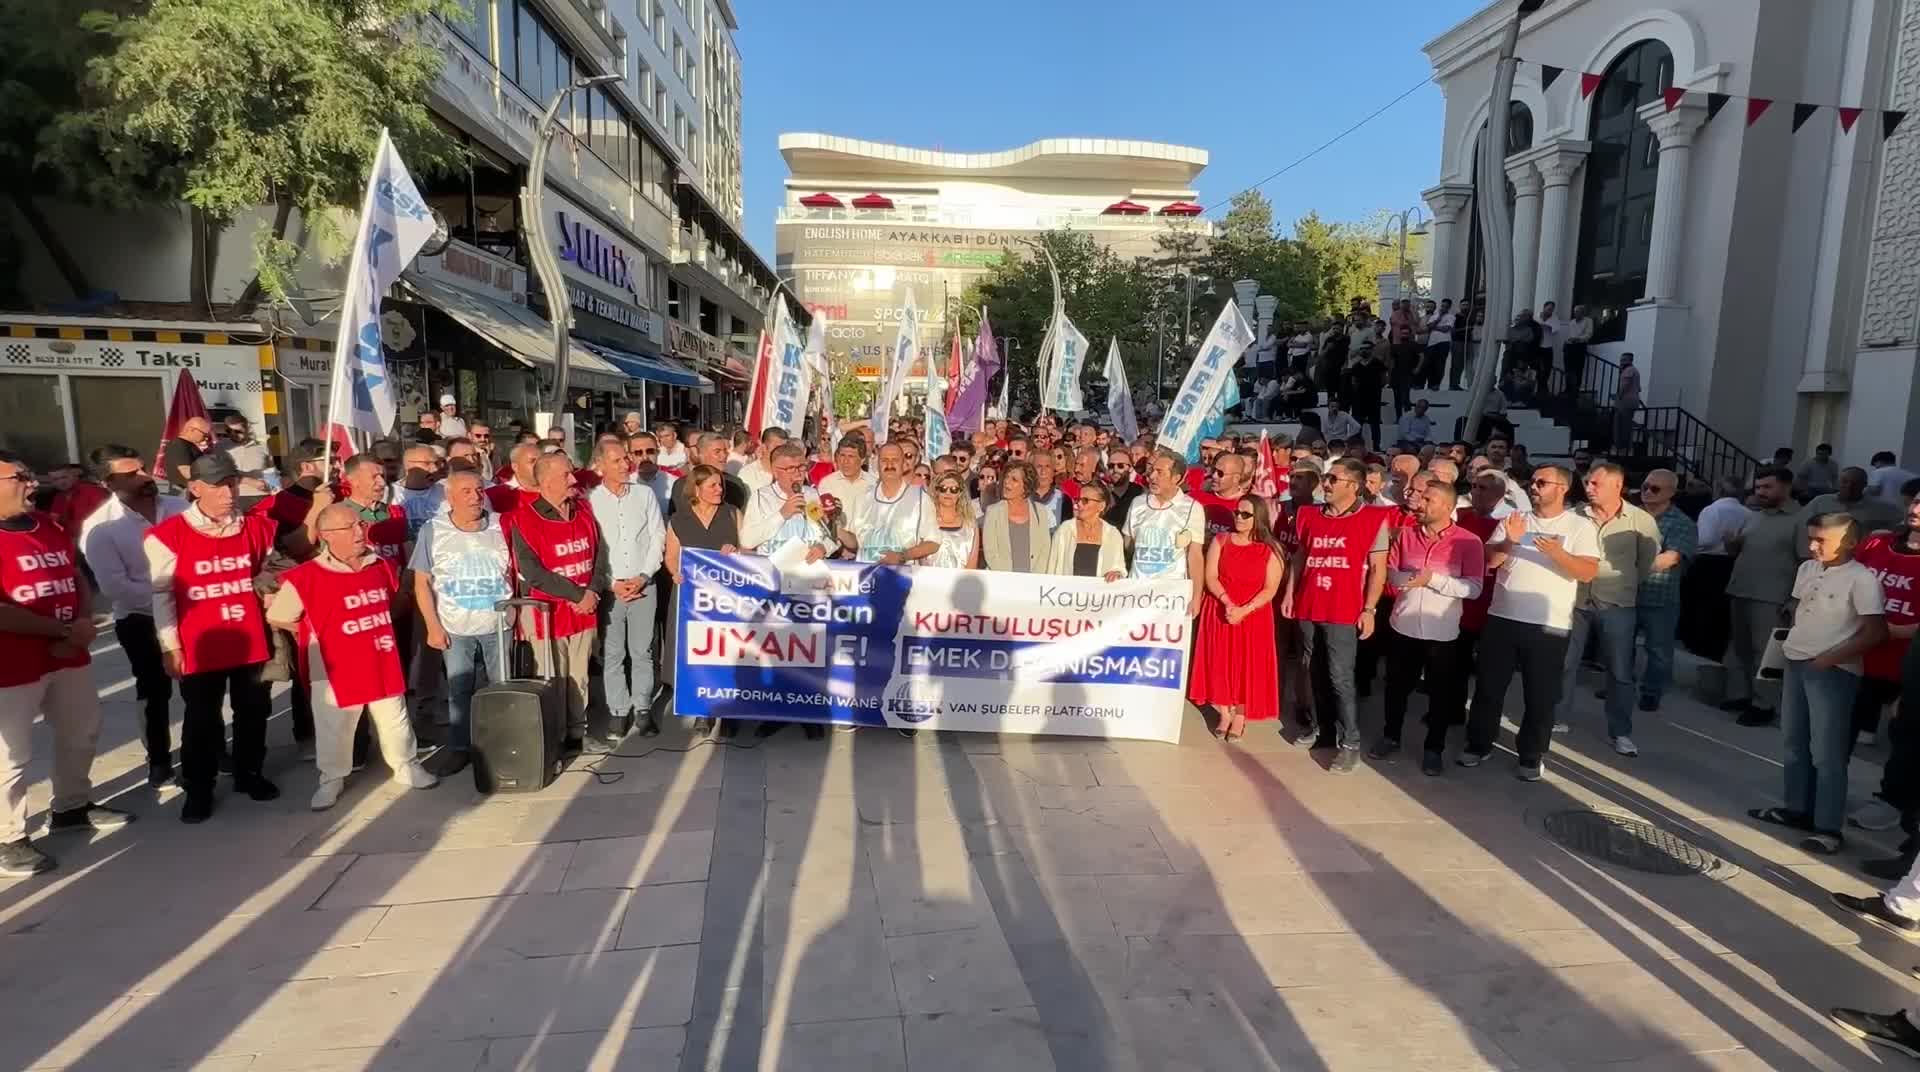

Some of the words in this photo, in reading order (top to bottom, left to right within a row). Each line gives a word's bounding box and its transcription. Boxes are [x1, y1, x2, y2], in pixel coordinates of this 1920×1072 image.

[805, 227, 850, 240] ENGLISH
[851, 228, 881, 241] HOME
[889, 231, 969, 244] AYAKKABI
[805, 269, 857, 281] TIFFANY
[136, 350, 201, 368] Taksi
[195, 379, 240, 391] Murat
[1163, 345, 1227, 440] KESK
[555, 537, 590, 557] DİSK
[16, 549, 71, 572] DİSK
[194, 553, 252, 575] DİSK
[552, 558, 593, 577] GENE
[1306, 555, 1350, 569] GENEL
[11, 576, 76, 603] GENE
[187, 577, 253, 600] GENE
[693, 588, 873, 625] Berxwedan
[1039, 585, 1186, 613] Kayyımdan
[221, 603, 246, 622] İŞ
[341, 610, 393, 635] GEN
[1124, 622, 1184, 643] OLU
[691, 626, 817, 664] JİYAN
[833, 635, 869, 666] E!
[907, 645, 981, 669] EMEK
[990, 650, 1177, 680] DNIŞMASI!
[697, 687, 783, 702] PLATFORMA
[950, 703, 977, 714] VAN
[981, 703, 1040, 716] ŞUBELER
[1044, 704, 1124, 719] PLATFORMU
